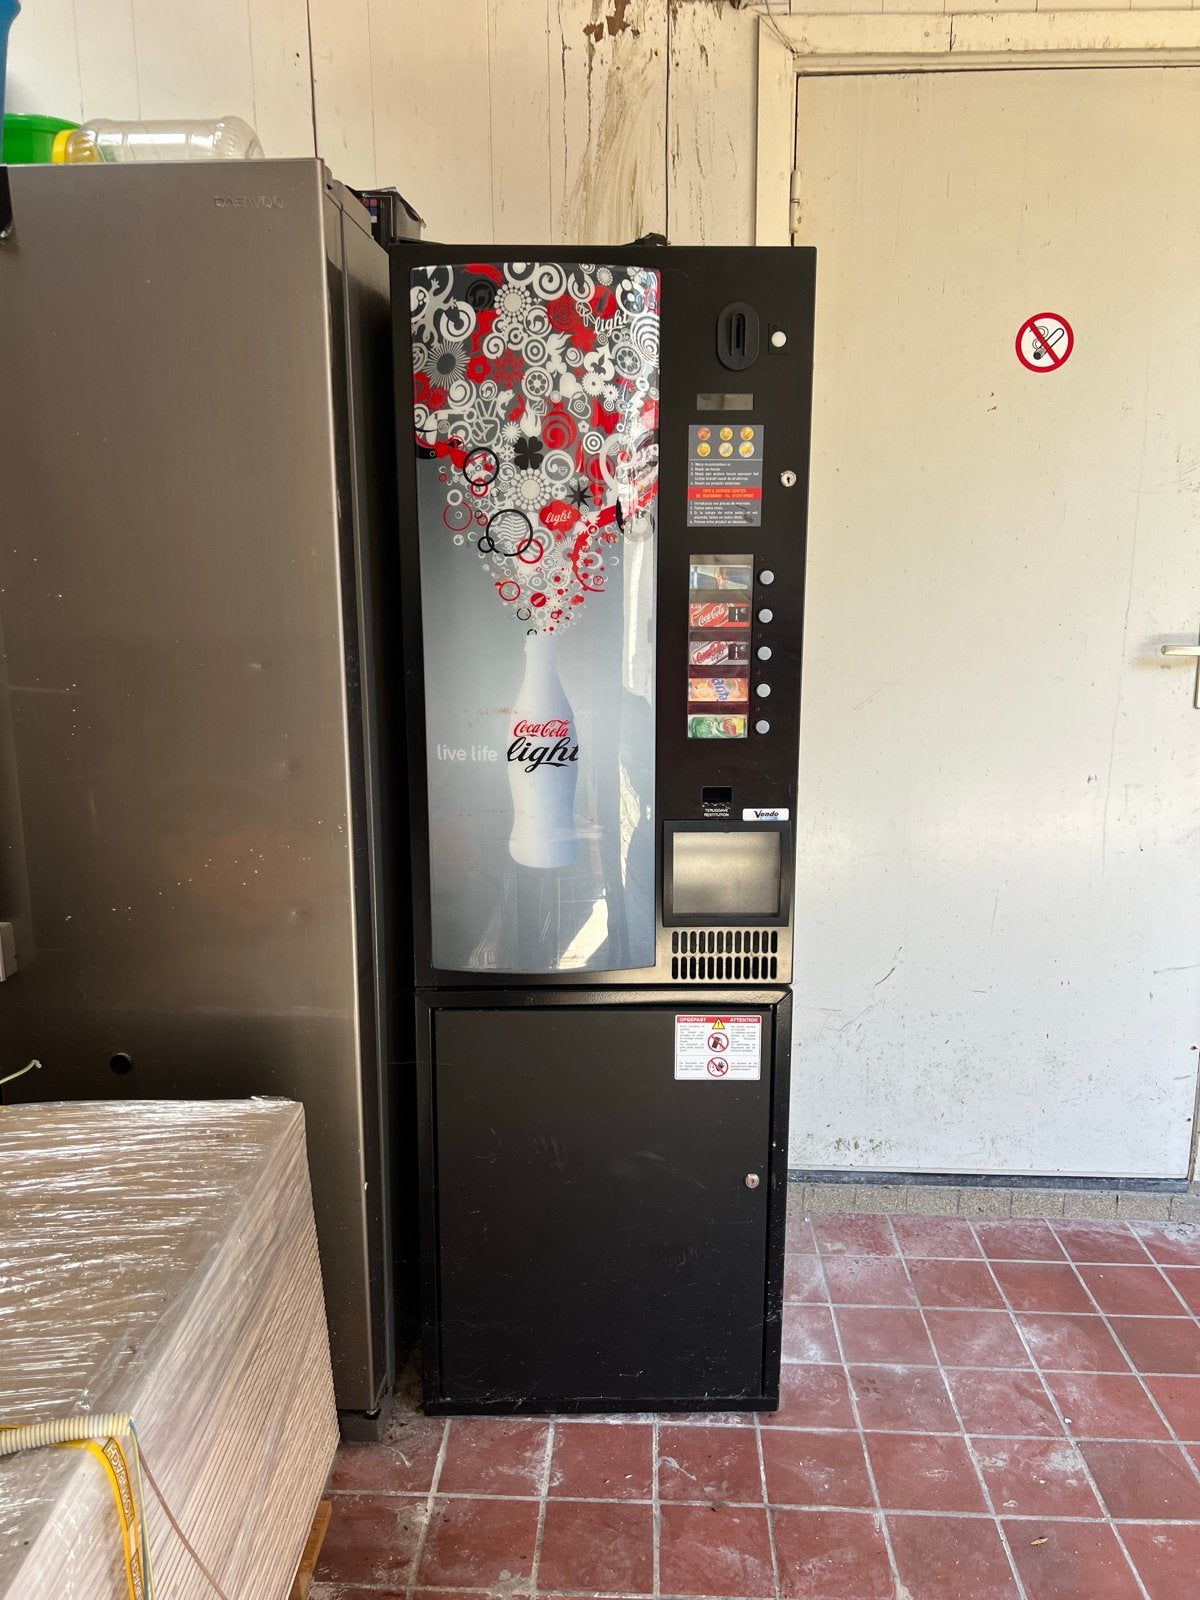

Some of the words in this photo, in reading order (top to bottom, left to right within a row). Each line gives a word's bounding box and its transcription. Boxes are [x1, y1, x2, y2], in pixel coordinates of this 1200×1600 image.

[213, 195, 284, 209] DAEWOO
[593, 309, 630, 338] light
[545, 509, 572, 527] light
[436, 744, 467, 761] live
[471, 745, 499, 762] life
[506, 736, 579, 774] light
[754, 809, 780, 819] Vendo
